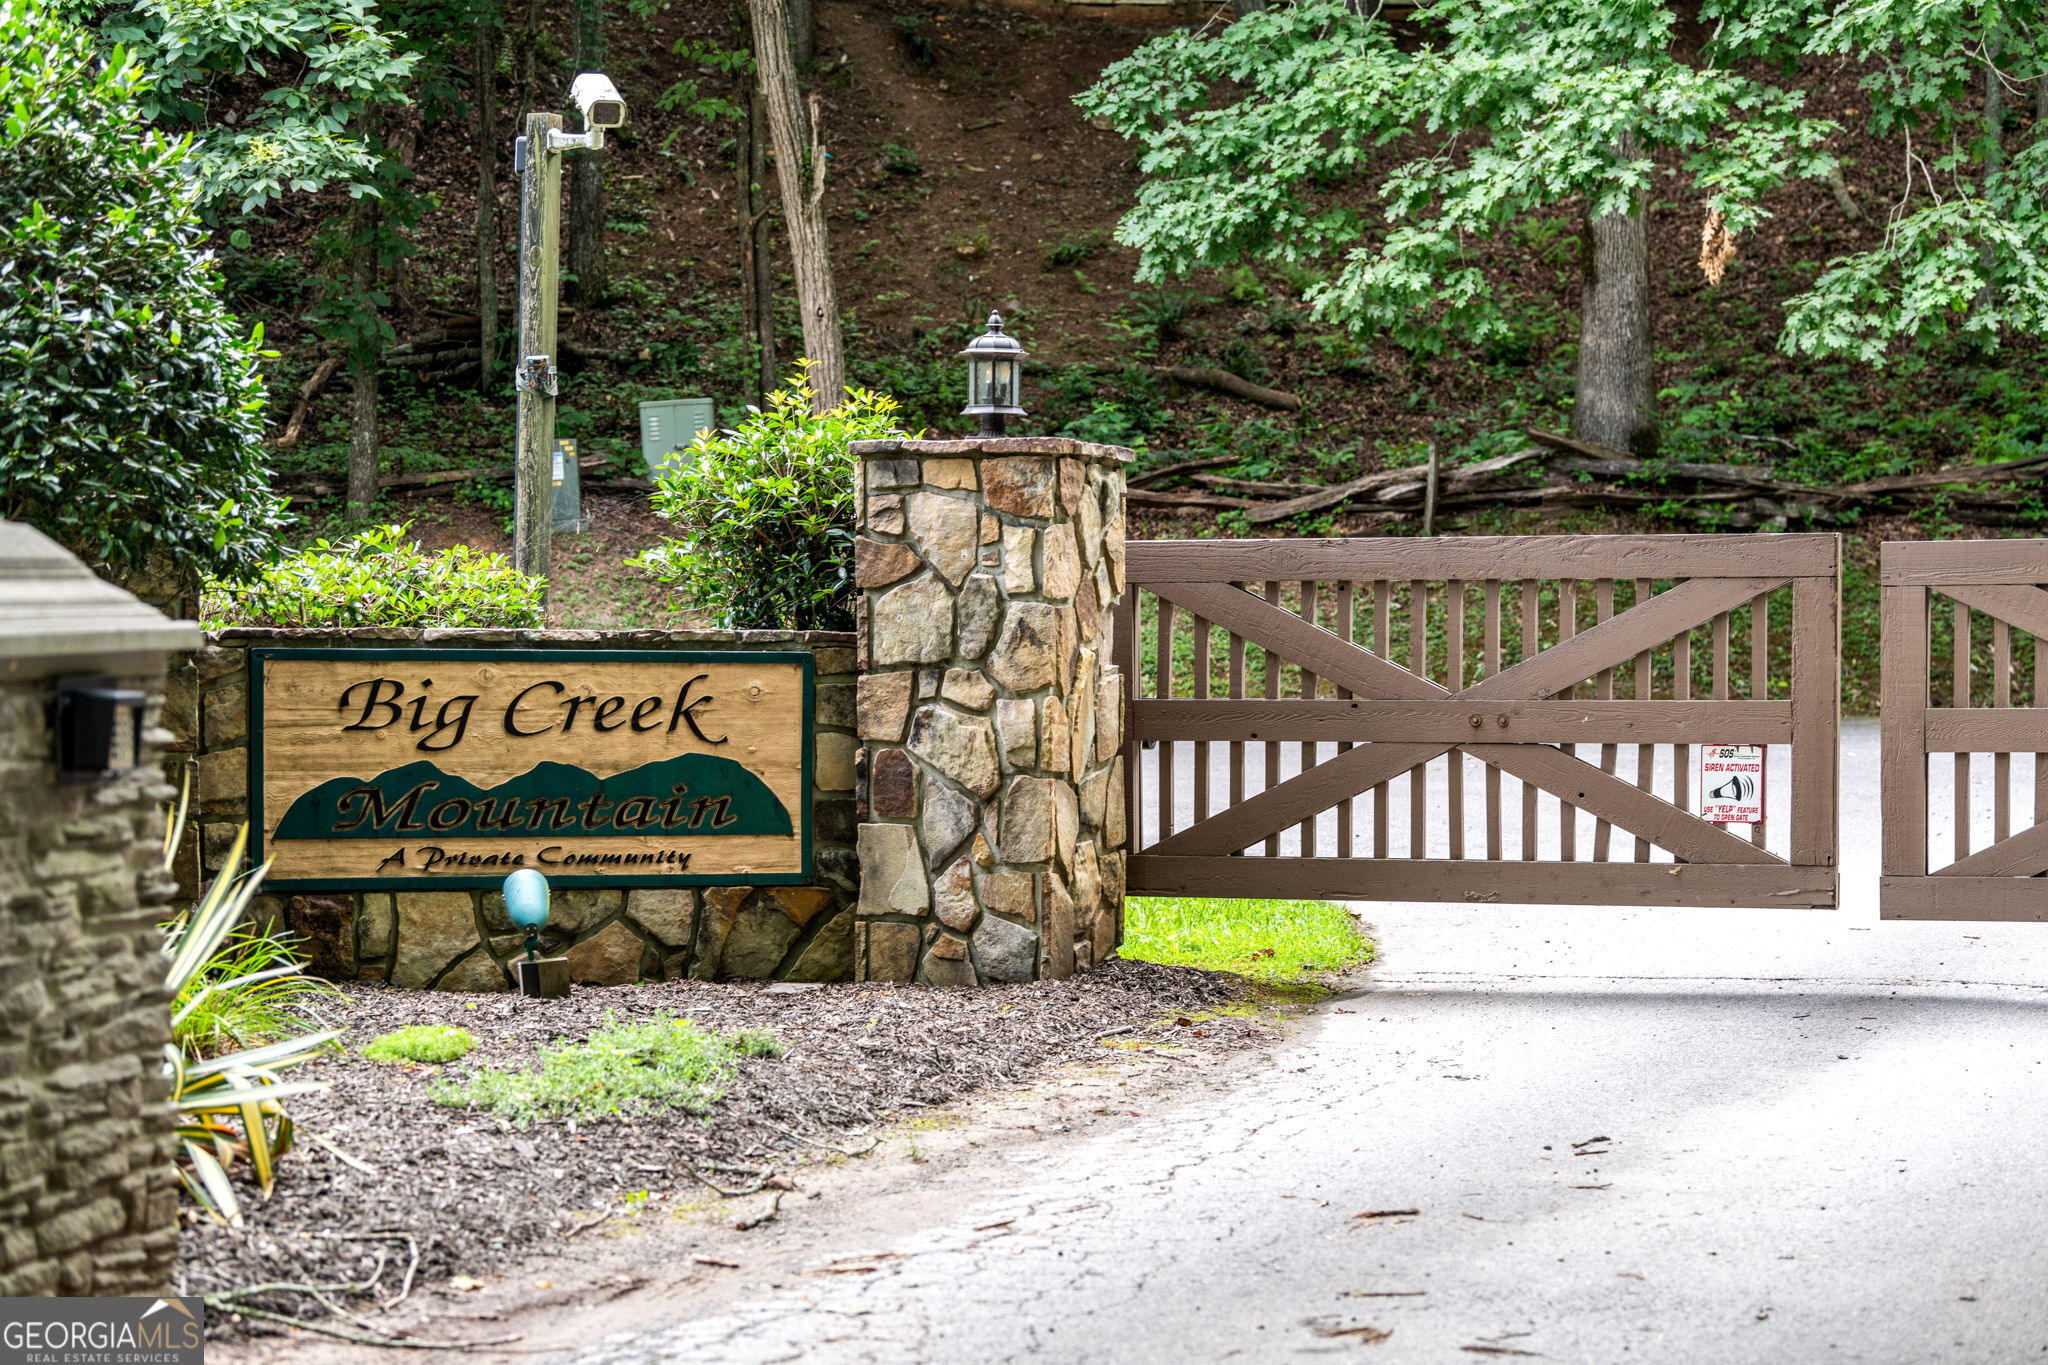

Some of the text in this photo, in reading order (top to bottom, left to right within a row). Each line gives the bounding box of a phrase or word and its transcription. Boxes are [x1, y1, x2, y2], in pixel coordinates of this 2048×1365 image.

[339, 673, 728, 752] Big Creek
[1719, 749, 1734, 758] SOS
[1704, 763, 1760, 773] SIREN ACTIVATED
[331, 780, 738, 832] Mountain
[377, 846, 693, 872] A Private Community
